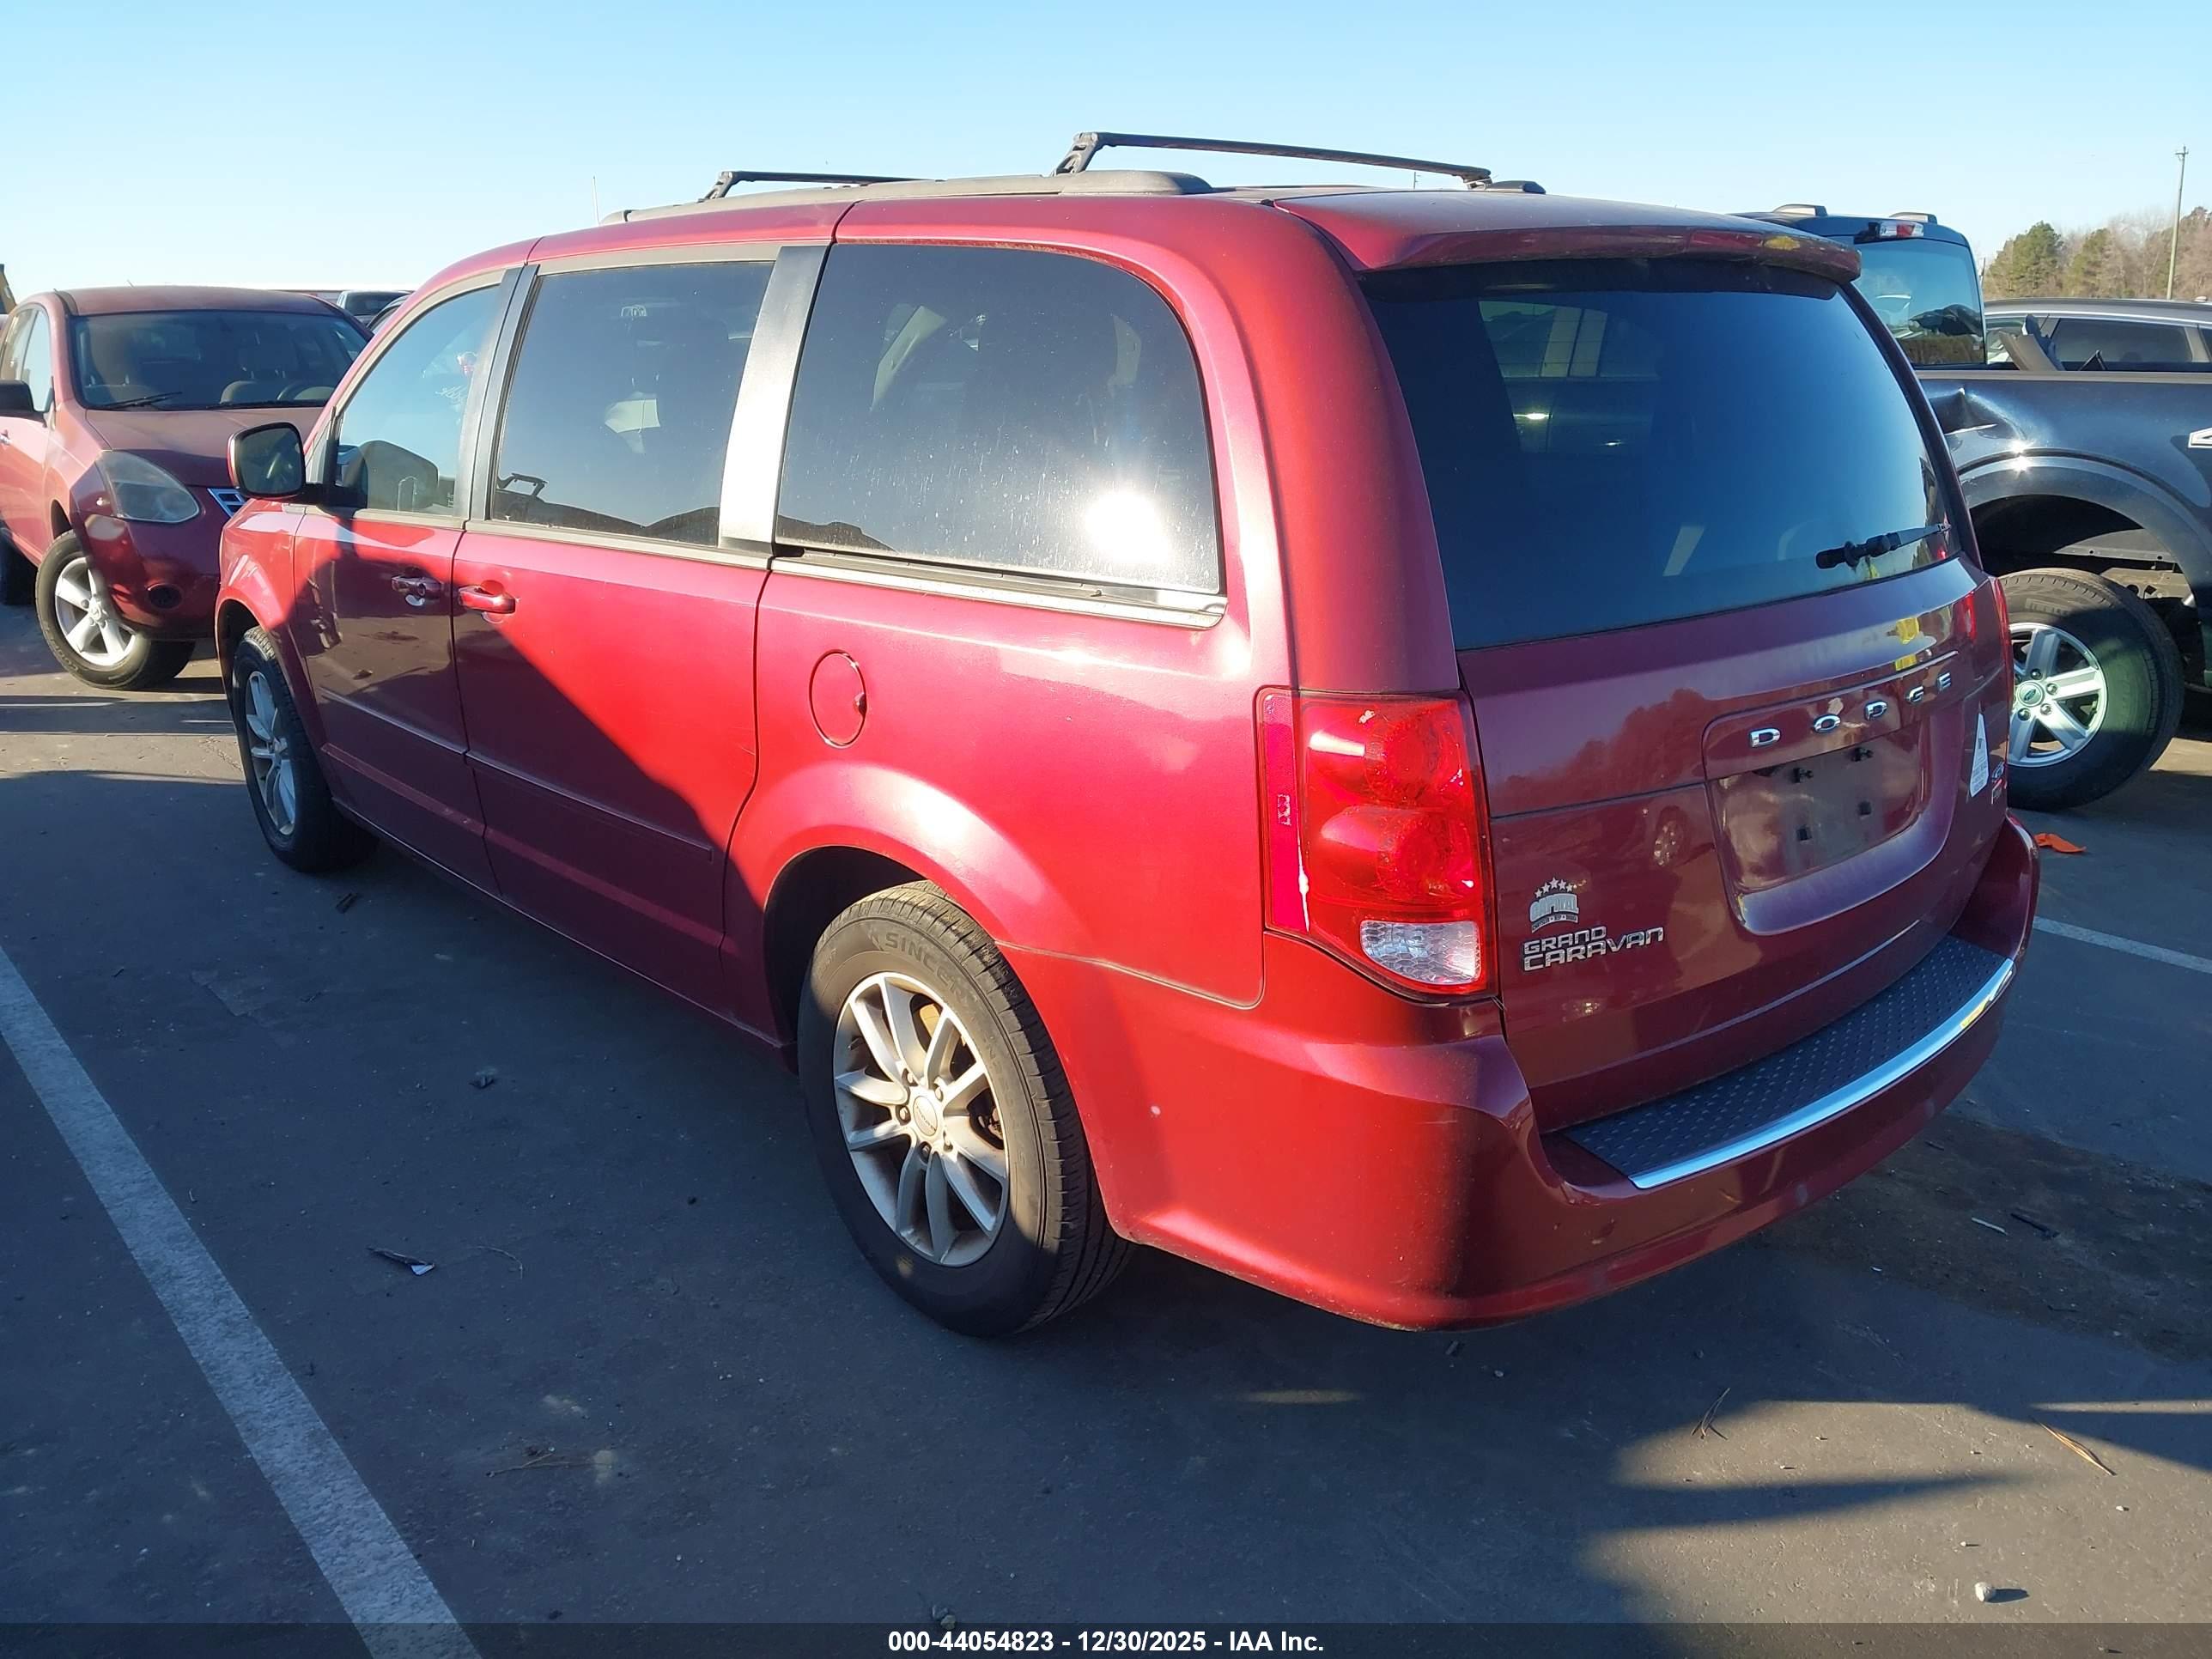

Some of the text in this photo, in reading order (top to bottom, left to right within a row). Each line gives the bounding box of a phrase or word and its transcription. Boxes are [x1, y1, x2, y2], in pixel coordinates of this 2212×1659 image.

[1751, 672, 1951, 749] DODGE
[1524, 927, 1607, 955] GRAND
[1524, 927, 1663, 971] CARAVAN
